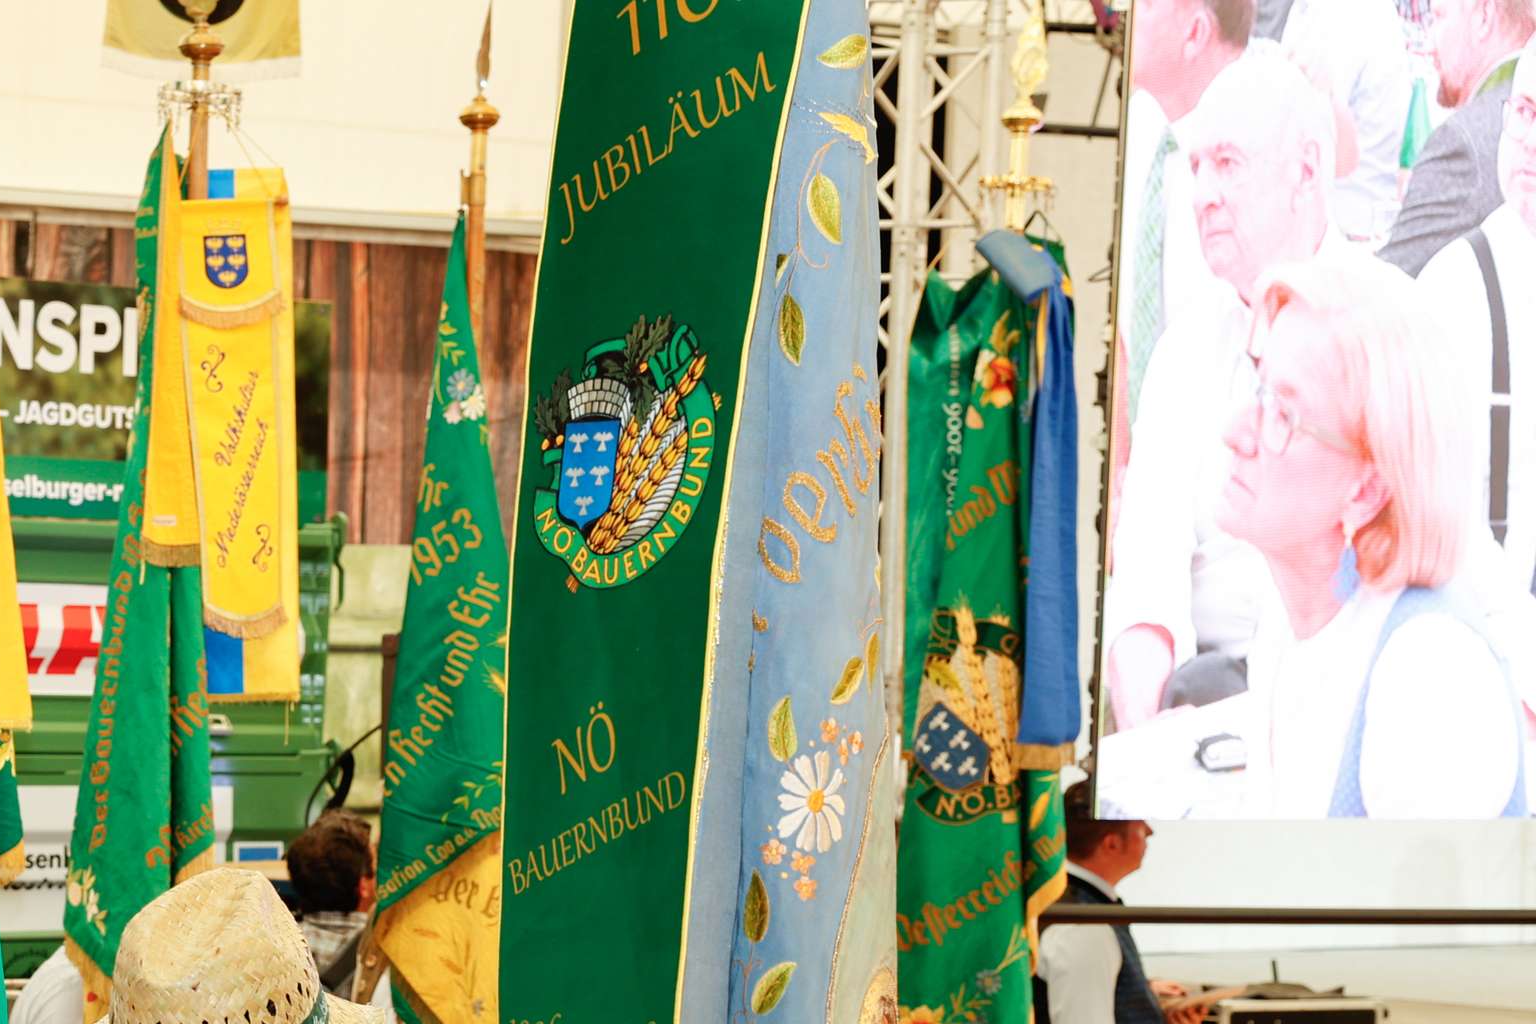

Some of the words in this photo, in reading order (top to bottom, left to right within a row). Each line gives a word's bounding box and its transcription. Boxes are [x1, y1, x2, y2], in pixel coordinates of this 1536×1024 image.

[558, 50, 777, 245] JUBILÄUM
[410, 507, 485, 586] 1953
[438, 629, 482, 689] und
[550, 700, 617, 796] NÖ
[508, 770, 687, 896] BAUERNBUND
